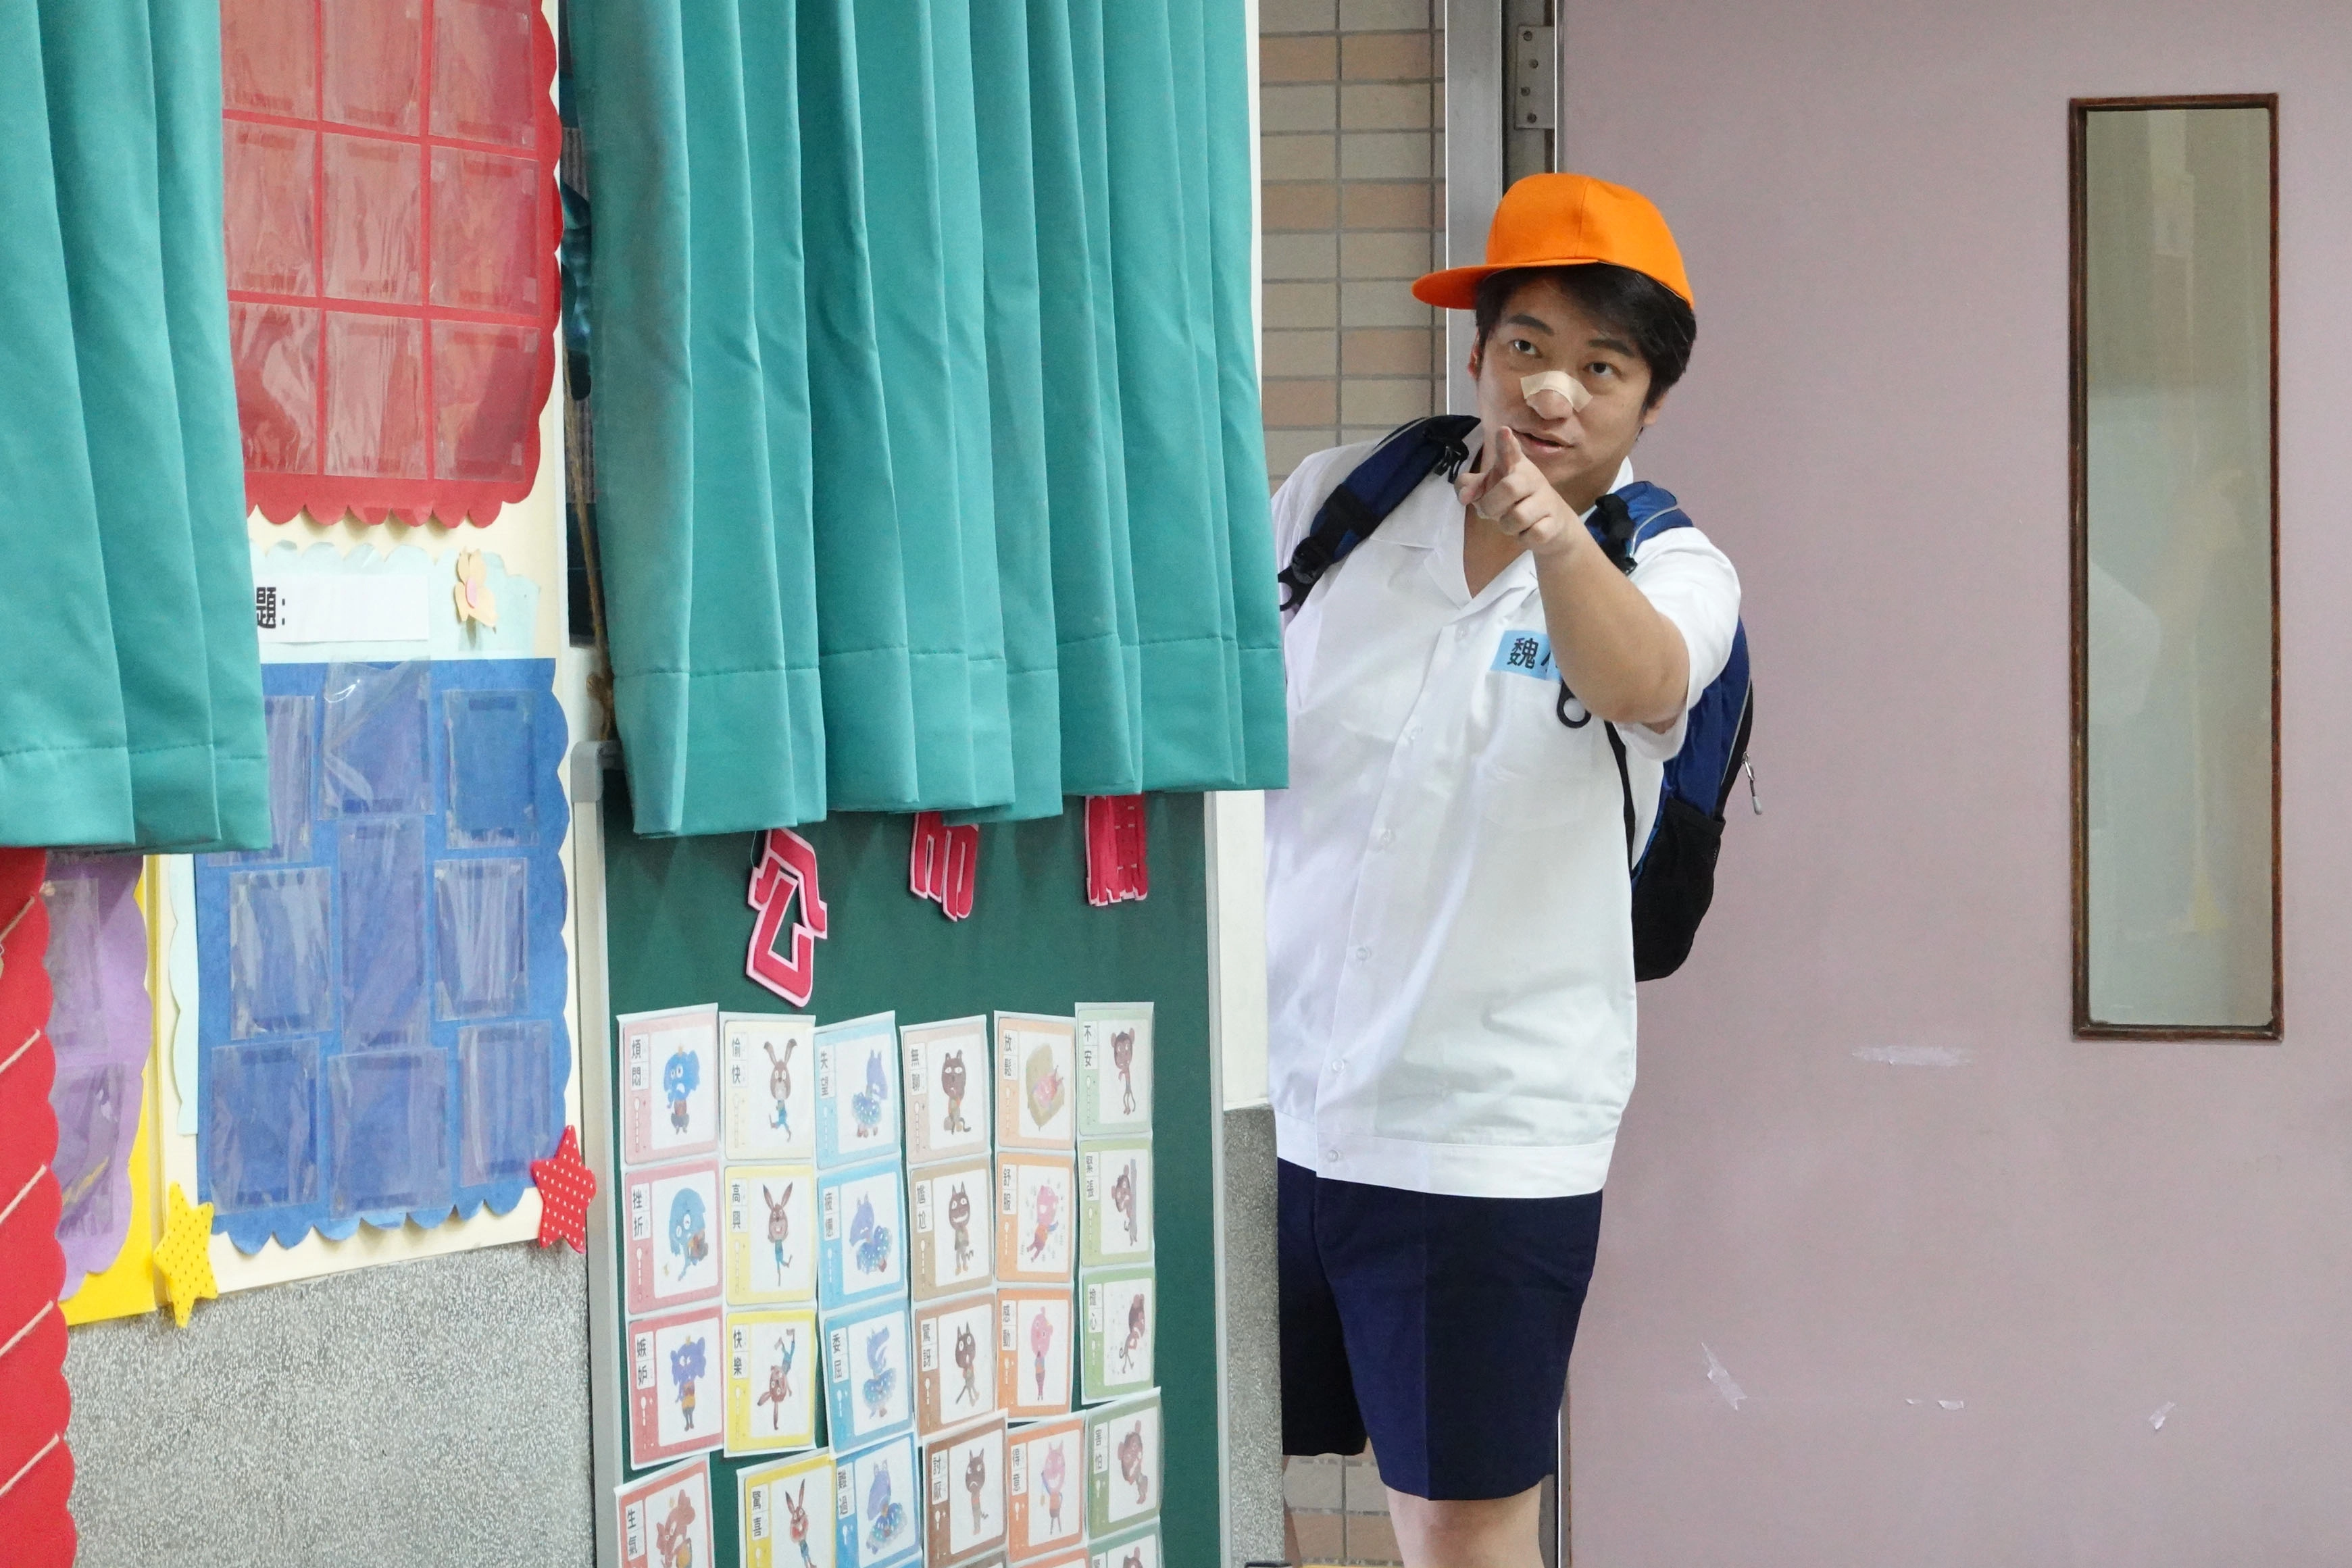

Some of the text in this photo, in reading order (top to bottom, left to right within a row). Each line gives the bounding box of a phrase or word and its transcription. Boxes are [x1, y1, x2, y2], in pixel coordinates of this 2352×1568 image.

[1507, 637, 1559, 669] 魏
[632, 1039, 642, 1087] 煩悶
[732, 1038, 741, 1084] 愉快
[1084, 1025, 1092, 1067] 不安
[820, 1050, 828, 1096] 失望
[632, 1188, 643, 1238] 挫折
[732, 1184, 741, 1229] 高興
[636, 1338, 648, 1386] 嫉妒
[733, 1329, 743, 1375] 快樂
[832, 1333, 843, 1380] 委屈
[627, 1508, 638, 1557] 生氣
[752, 1490, 762, 1538] 驚喜
